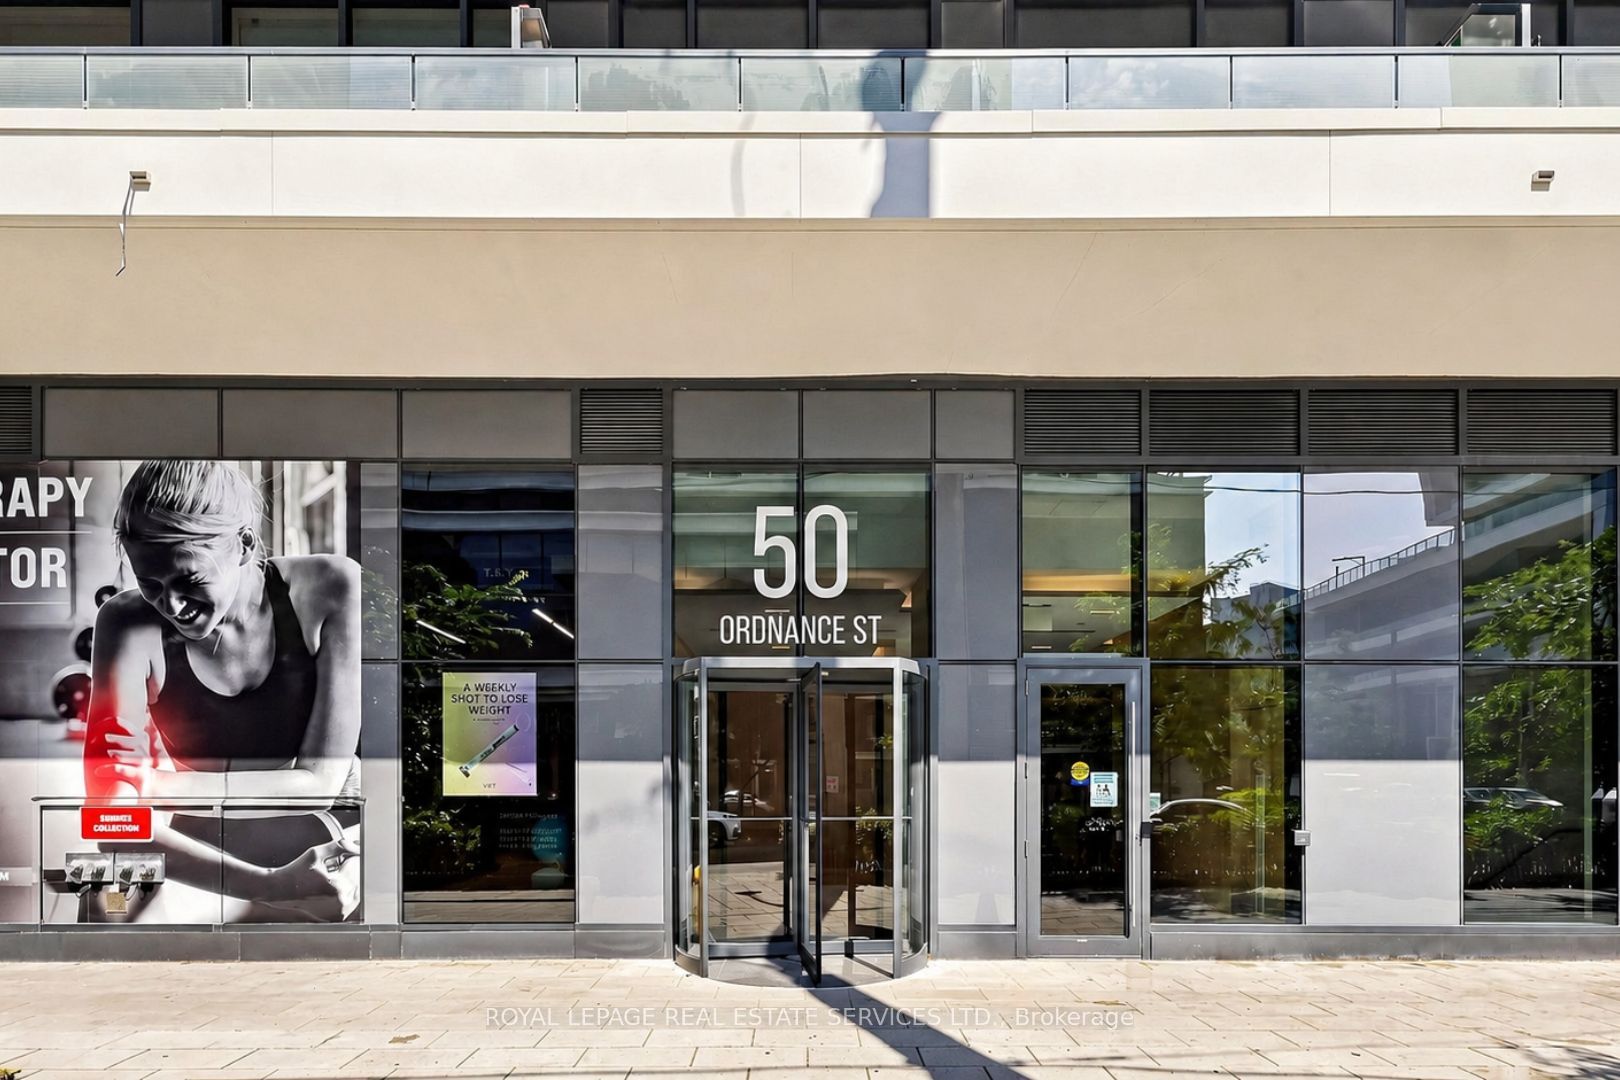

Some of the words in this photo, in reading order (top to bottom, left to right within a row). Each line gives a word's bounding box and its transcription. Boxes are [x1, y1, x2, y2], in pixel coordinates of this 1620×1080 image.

[0, 477, 93, 517] APY
[754, 504, 849, 599] 50
[719, 615, 846, 645] ORDNANCE
[853, 615, 882, 645] ST
[463, 683, 471, 692] A
[475, 682, 517, 692] WEEKLY
[451, 694, 480, 703] SHOT
[484, 694, 498, 703] TO
[501, 694, 528, 703] LOSE
[468, 705, 512, 715] WEIGHT
